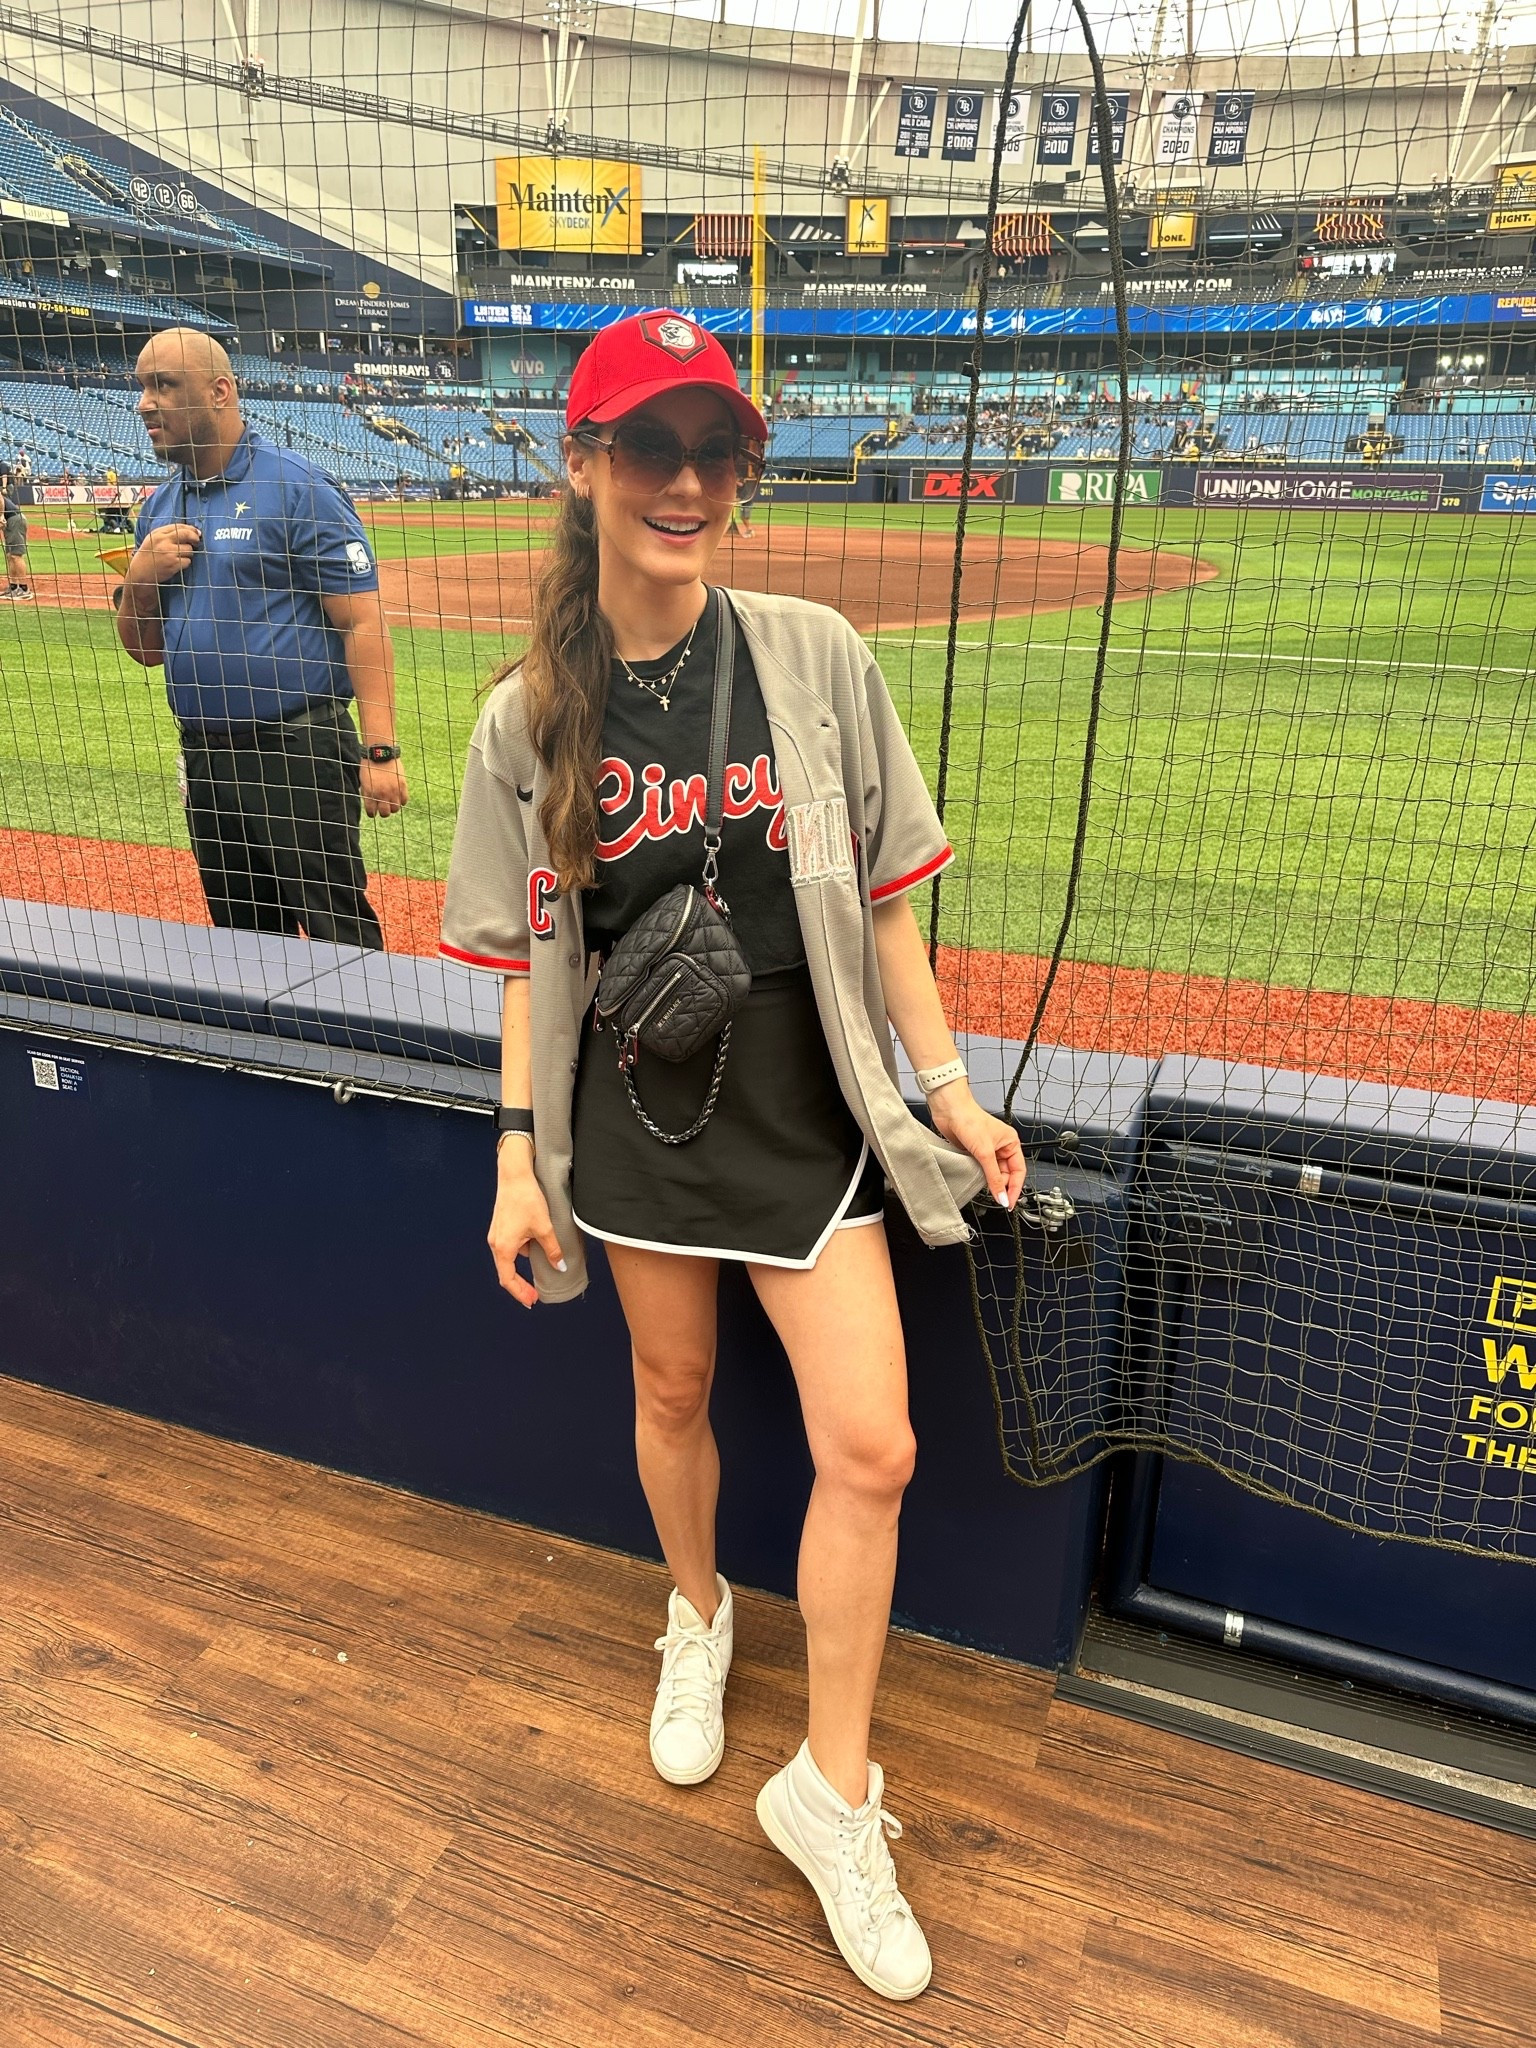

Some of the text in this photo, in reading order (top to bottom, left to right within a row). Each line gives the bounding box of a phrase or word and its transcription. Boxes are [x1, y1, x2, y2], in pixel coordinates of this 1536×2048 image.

[947, 122, 978, 131] CHAMPIONS
[1163, 126, 1195, 134] CHAMPIONS
[1213, 126, 1247, 135] CHAMPIONS
[947, 135, 974, 151] 2008
[1044, 140, 1069, 154] 2010
[1091, 140, 1120, 154] 20
[1162, 140, 1190, 154] 2020
[1213, 140, 1241, 155] 2021
[134, 182, 148, 198] 42
[159, 188, 170, 204] 12
[181, 195, 194, 210] 66
[508, 182, 629, 228] MaintenX
[549, 215, 590, 229] SKYDECK
[1495, 213, 1532, 224] RIGHT.
[1157, 234, 1186, 243] DONE.
[511, 275, 635, 290] MAINTENX.COM
[803, 282, 927, 296] MAINTENX.COM
[1101, 278, 1232, 294] MINTENX.COM
[358, 307, 388, 316] TERRACE
[510, 359, 545, 375] VIVA
[1351, 489, 1429, 502] MORTGAGE
[1492, 481, 1536, 505] Spe
[1441, 497, 1460, 507] 378
[214, 527, 253, 541] SECURITY
[594, 754, 789, 862] Cincy
[527, 867, 558, 940] C
[1462, 1433, 1536, 1475] THE
